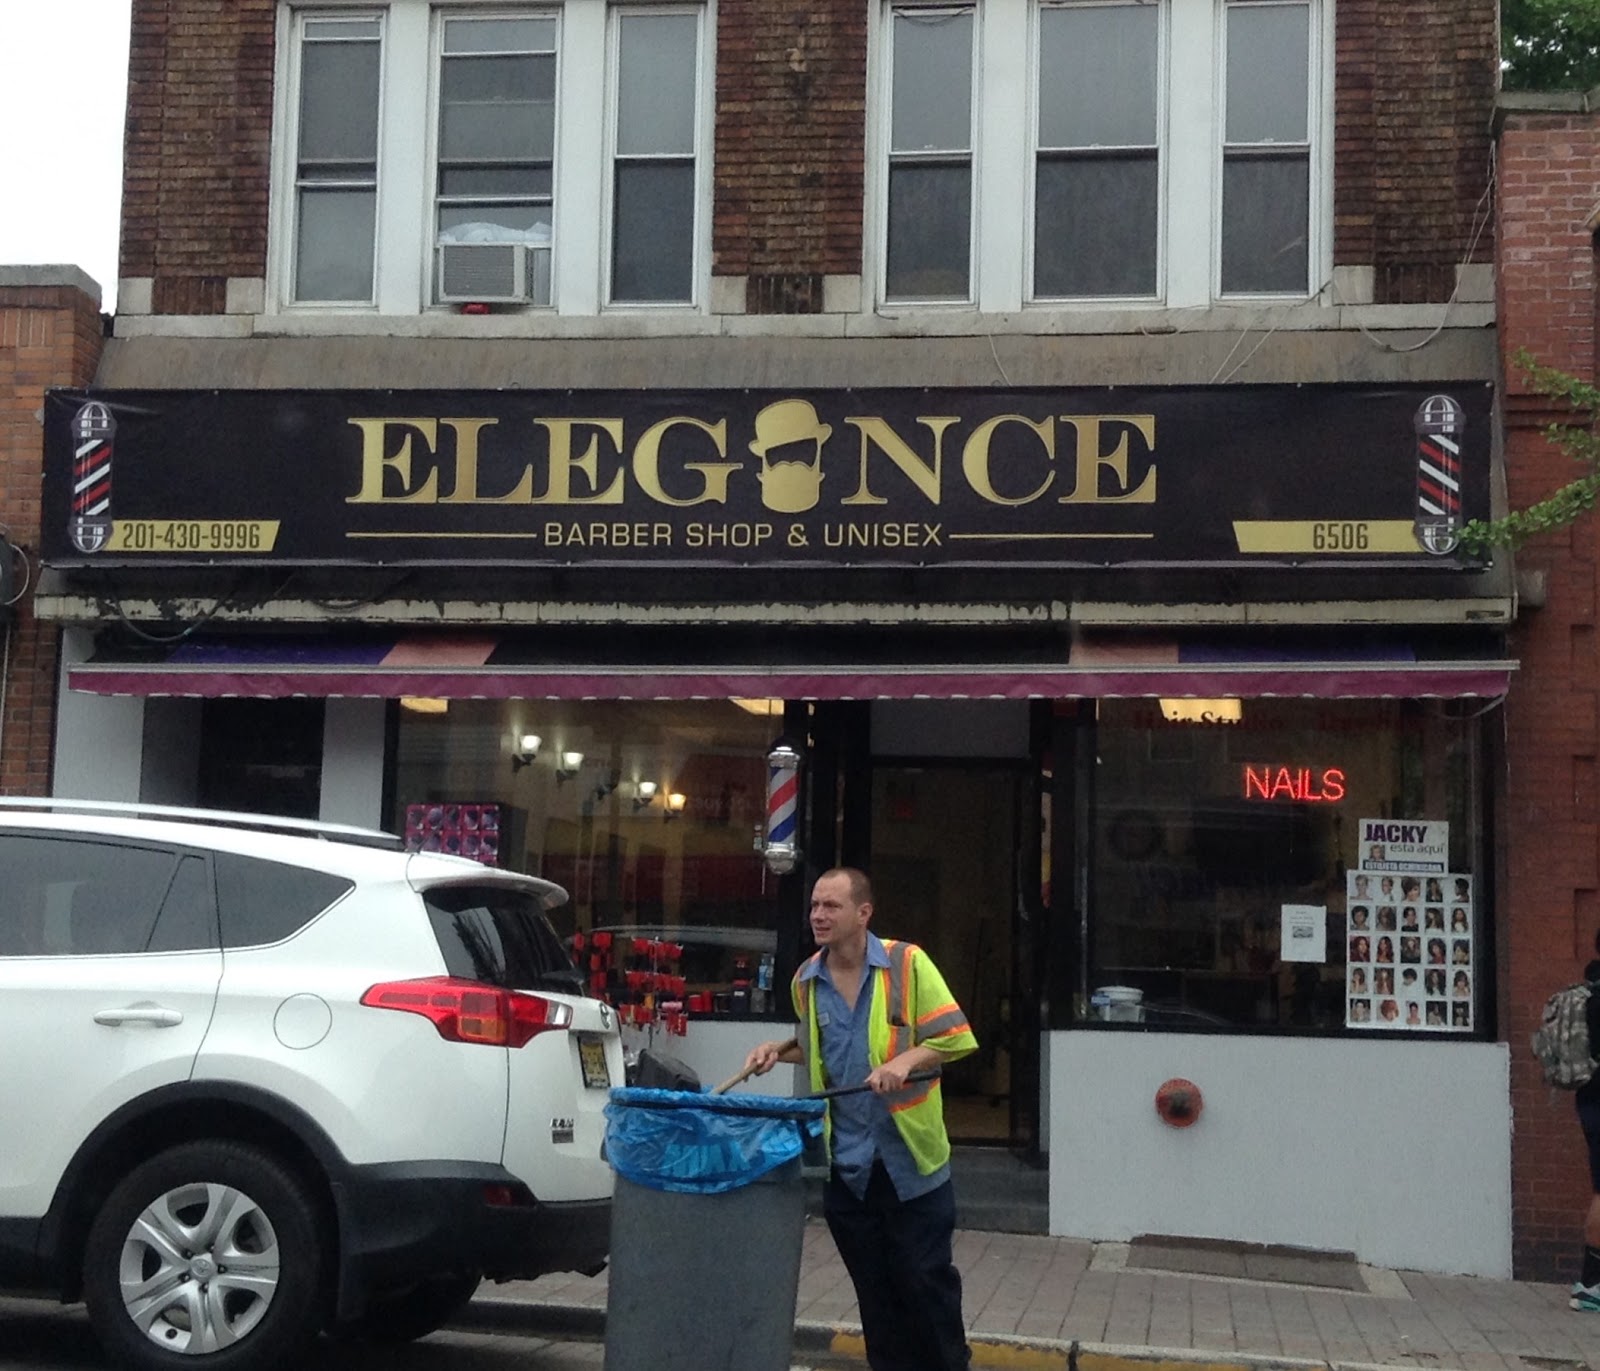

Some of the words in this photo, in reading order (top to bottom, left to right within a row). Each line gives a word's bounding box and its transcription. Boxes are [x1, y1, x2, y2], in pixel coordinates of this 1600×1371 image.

[122, 522, 260, 549] 201-430-9996
[544, 522, 672, 547] BARBER
[685, 522, 773, 547] SHOP
[787, 523, 810, 547] &
[824, 523, 943, 548] UNISEX
[1312, 522, 1369, 550] 6506
[1245, 765, 1345, 800] NAILS
[1364, 823, 1428, 843] JACKY
